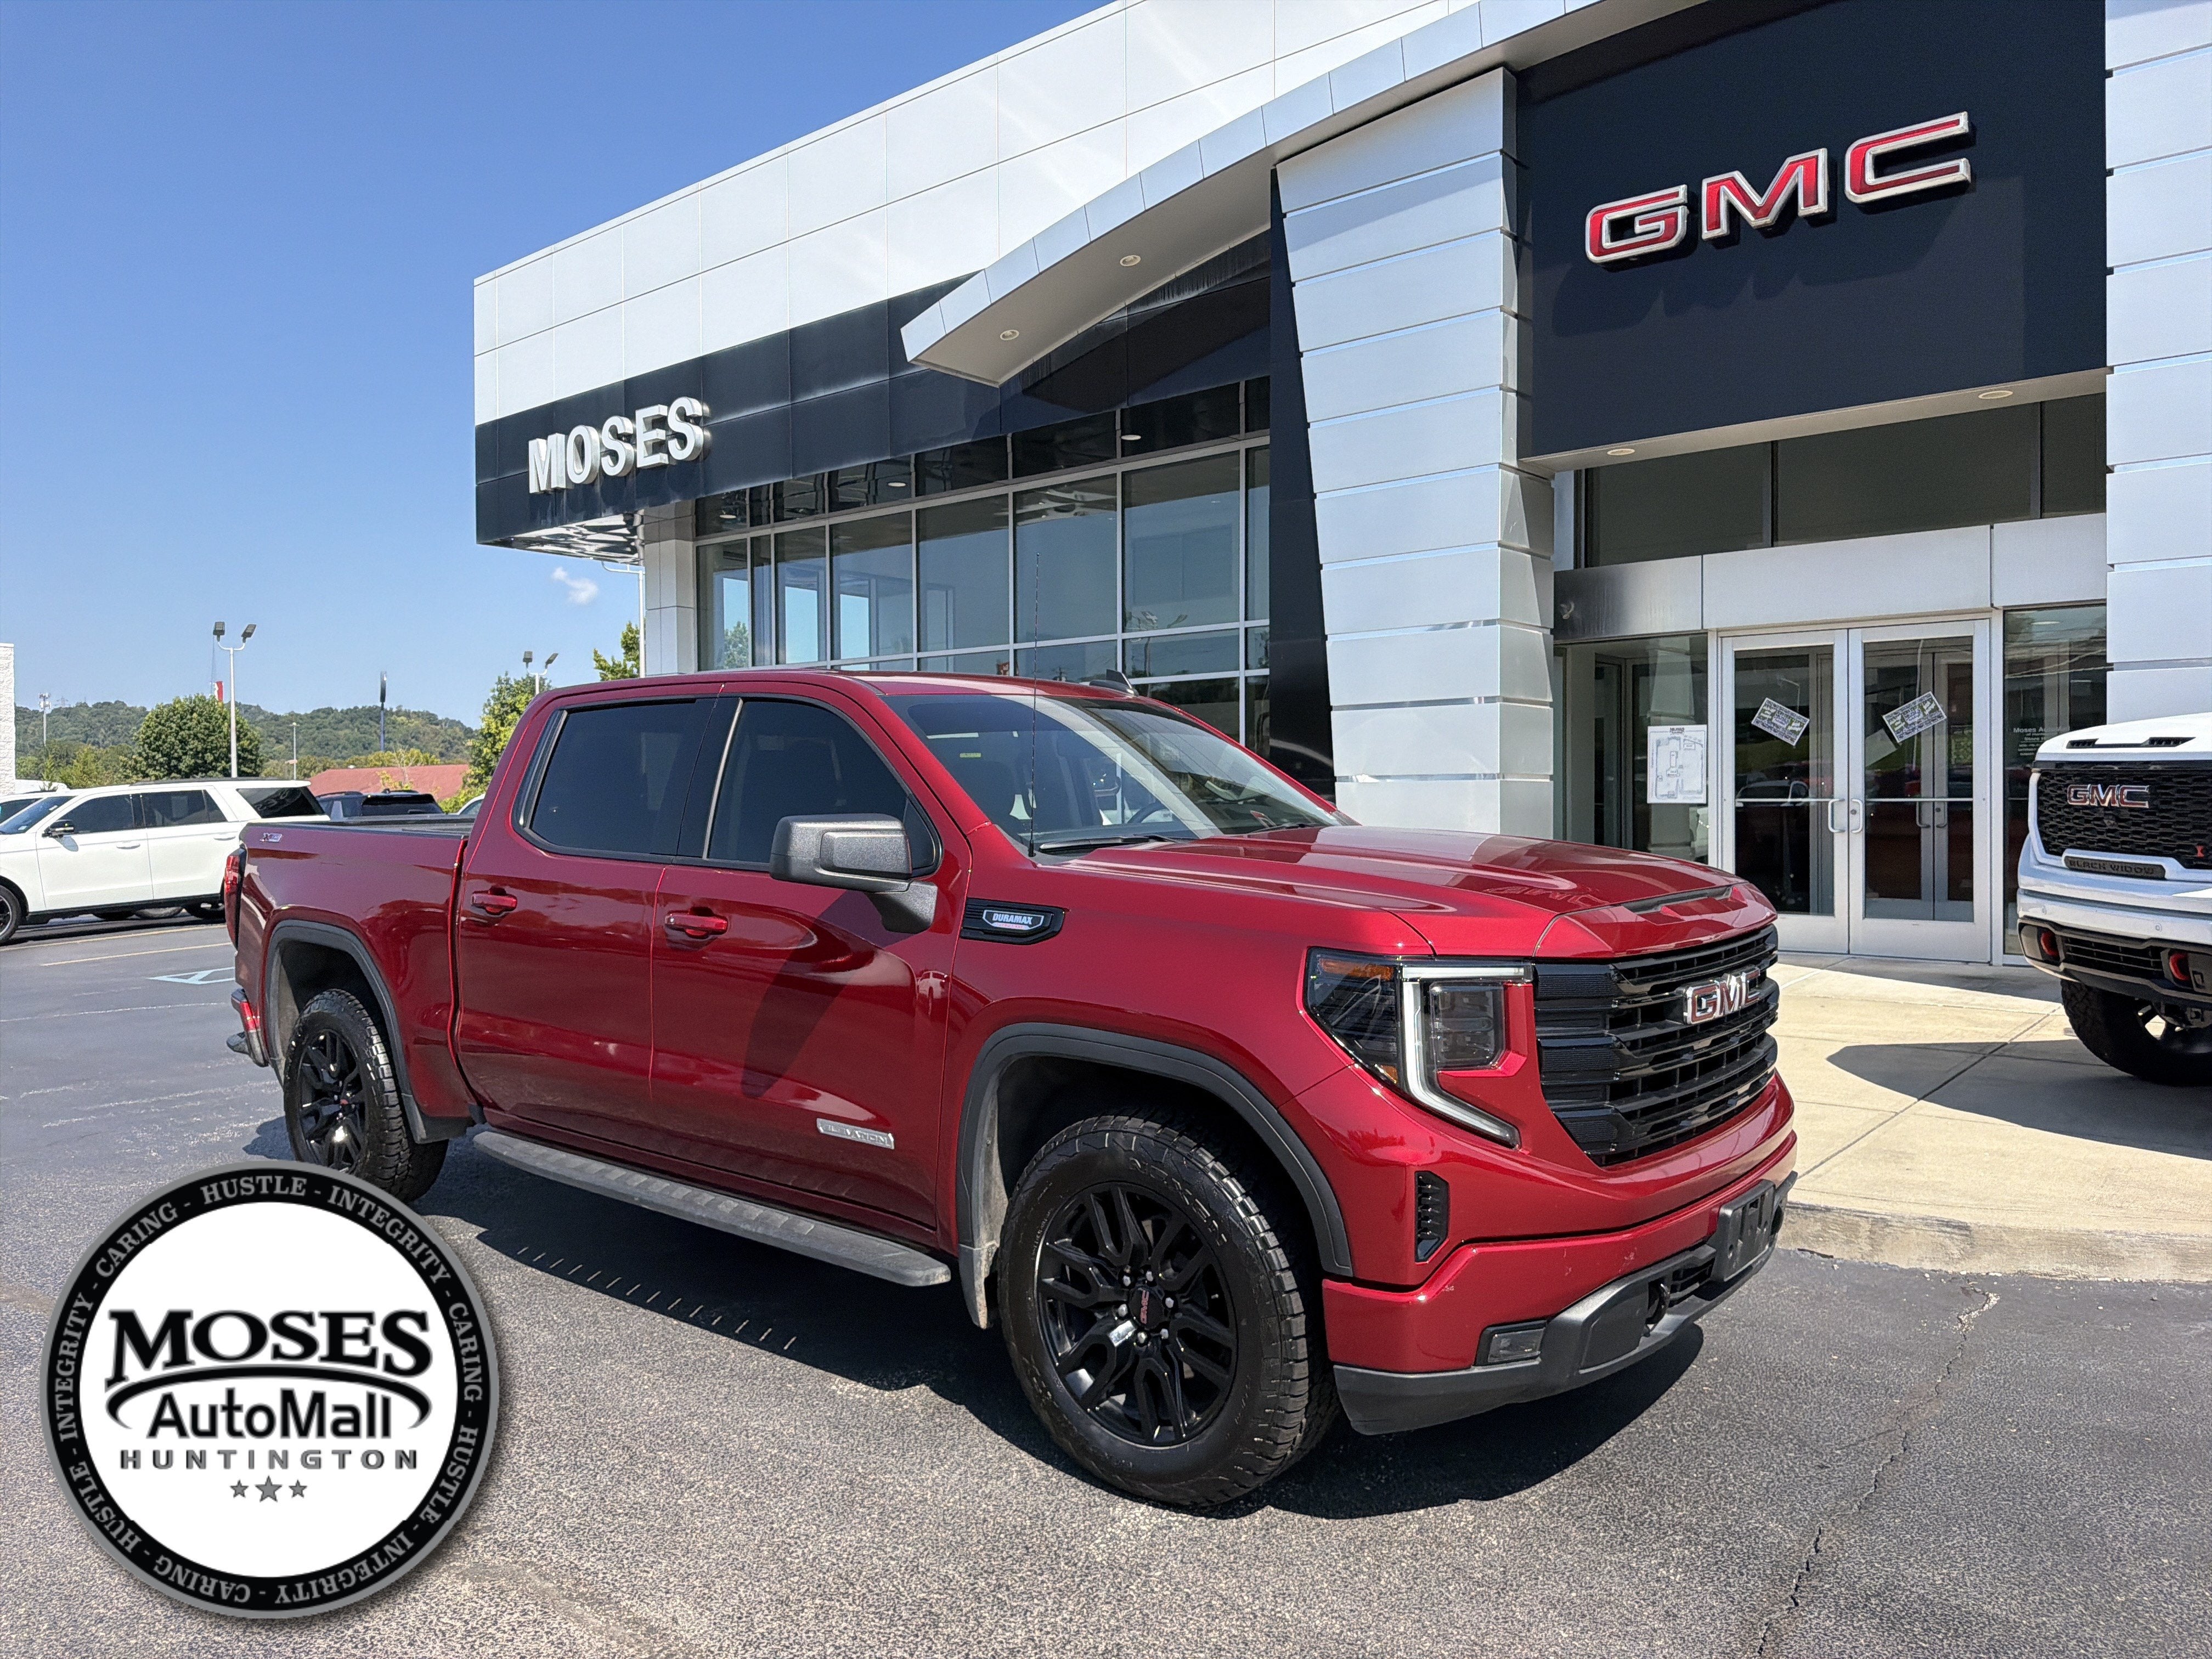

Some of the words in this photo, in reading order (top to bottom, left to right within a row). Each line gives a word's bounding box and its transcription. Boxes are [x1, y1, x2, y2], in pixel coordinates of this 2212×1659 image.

[1585, 111, 1972, 263] GMC
[528, 396, 704, 494] MOSES
[2067, 783, 2150, 809] GMC
[2069, 860, 2106, 870] BLACK
[2109, 864, 2154, 874] WIDOW
[992, 913, 1033, 925] DURAMAX
[1686, 967, 1760, 1025] GMC
[1140, 1290, 1150, 1324] GMC
